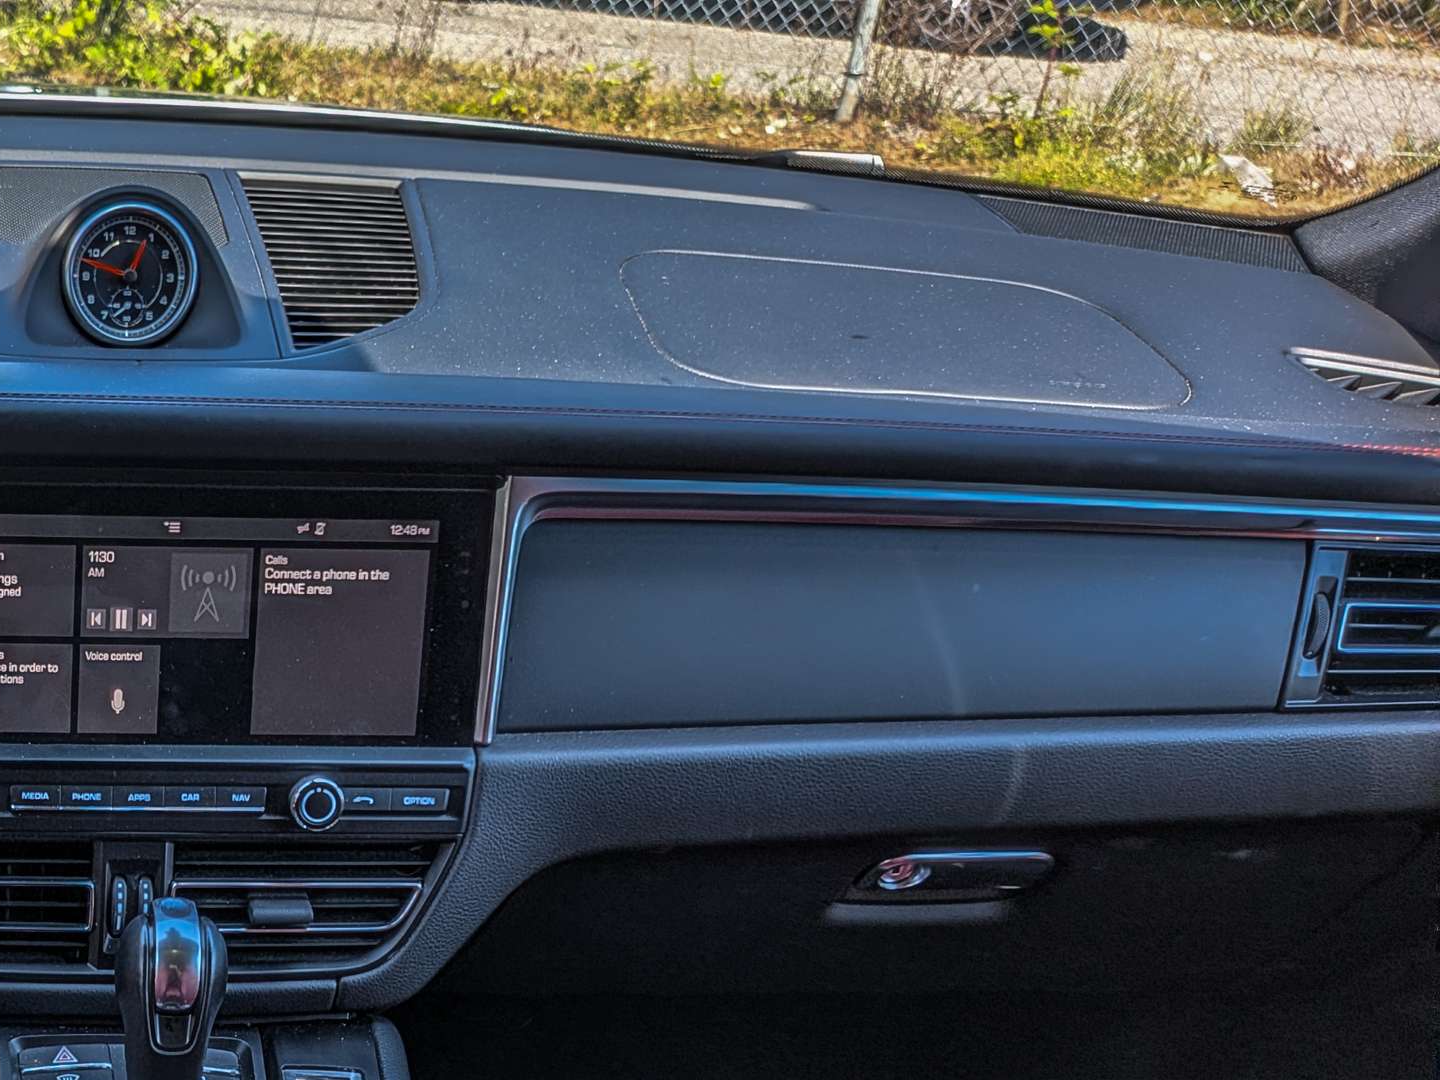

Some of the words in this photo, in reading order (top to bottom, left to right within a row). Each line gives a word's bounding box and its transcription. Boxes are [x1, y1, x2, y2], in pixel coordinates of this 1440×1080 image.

[124, 226, 137, 235] 12
[104, 232, 114, 241] 11
[149, 233, 154, 242] 1
[88, 249, 100, 258] 10
[161, 250, 169, 259] 2
[82, 271, 90, 281] 9
[166, 273, 174, 283] 3
[87, 295, 95, 304] 8
[160, 296, 167, 305] 4
[100, 311, 108, 320] 7
[145, 312, 153, 321] 5
[88, 551, 115, 563] 1130
[265, 555, 288, 565] Calls
[88, 568, 104, 577] AM
[265, 568, 312, 580] Connect
[313, 571, 320, 580] a
[322, 569, 357, 581] phone
[358, 569, 369, 580] in
[370, 569, 390, 580] the
[264, 583, 306, 595] PHONE
[306, 585, 332, 595] area
[85, 651, 109, 661] Voice
[110, 652, 143, 661] control
[9, 663, 17, 672] in
[19, 664, 46, 673] order
[48, 664, 58, 673] to
[21, 792, 49, 800] MEDIA
[72, 793, 102, 801] PHONE
[127, 793, 151, 802] APPS
[181, 793, 200, 801] CAR
[232, 794, 251, 802] NAV
[403, 796, 435, 805] OPTION
